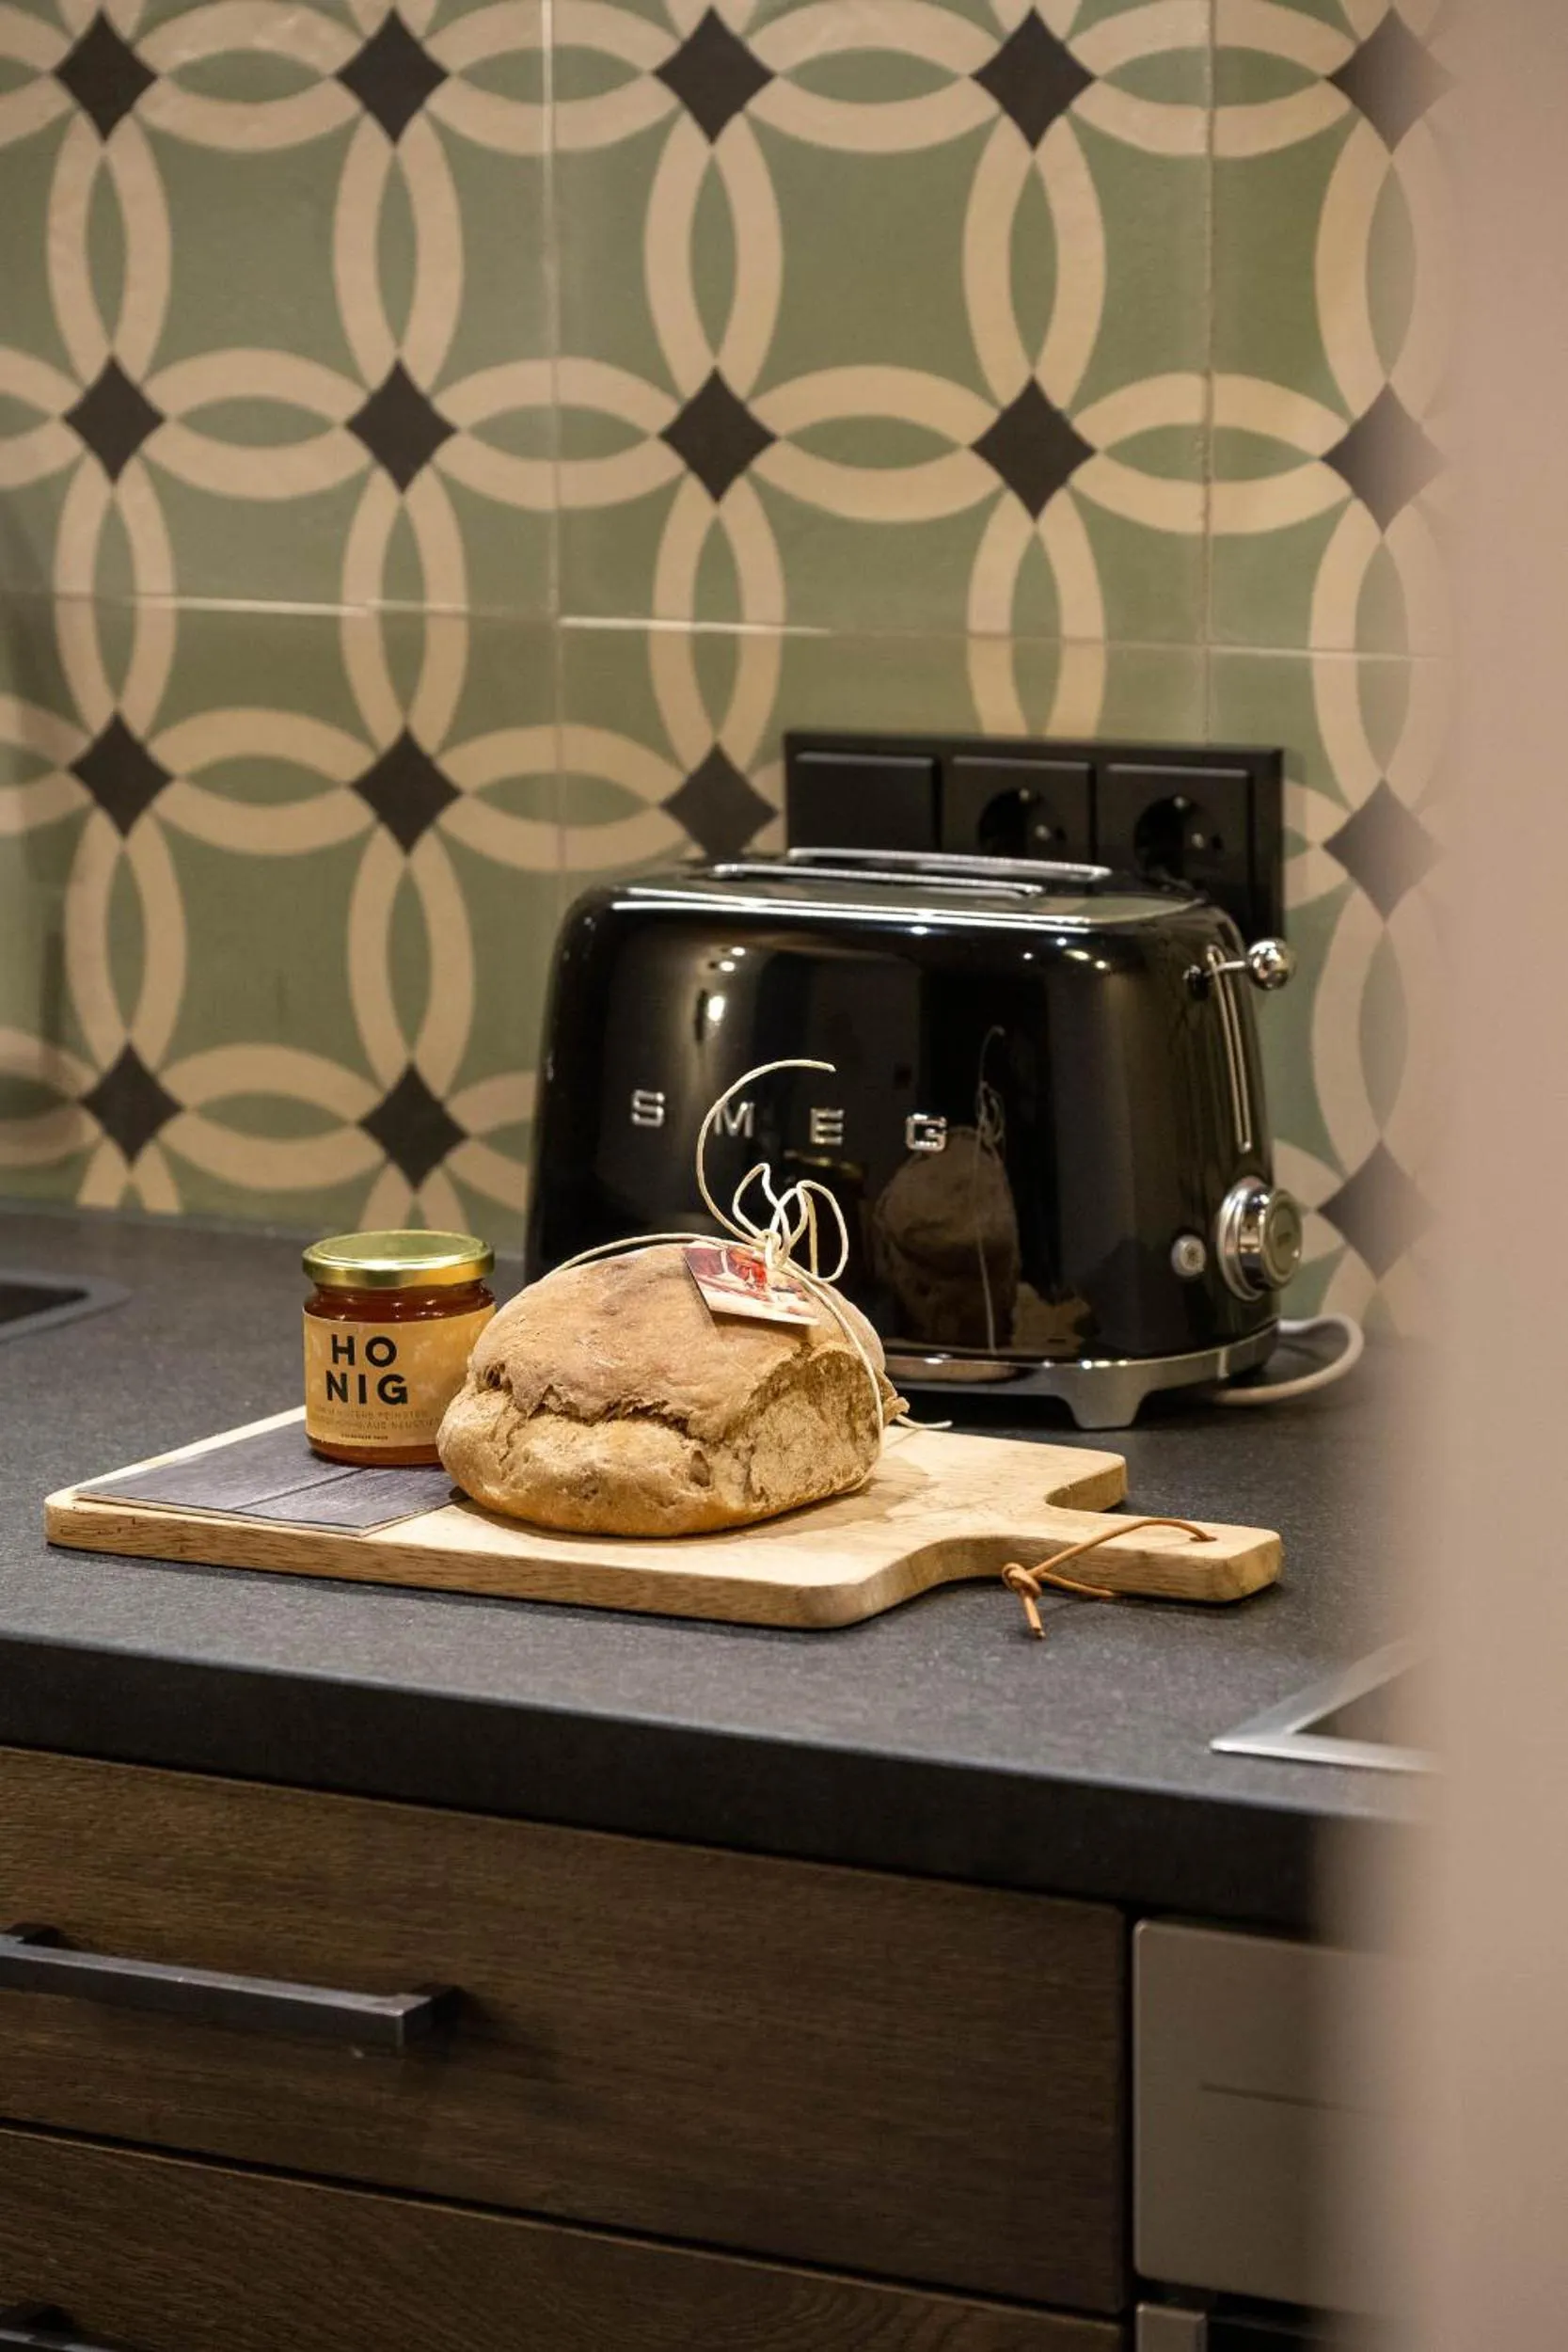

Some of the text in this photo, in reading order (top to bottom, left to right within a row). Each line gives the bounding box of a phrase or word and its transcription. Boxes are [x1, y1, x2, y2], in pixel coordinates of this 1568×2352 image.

[631, 1089, 946, 1152] SMEG
[331, 1334, 397, 1367] HO
[325, 1370, 407, 1405] NIG
